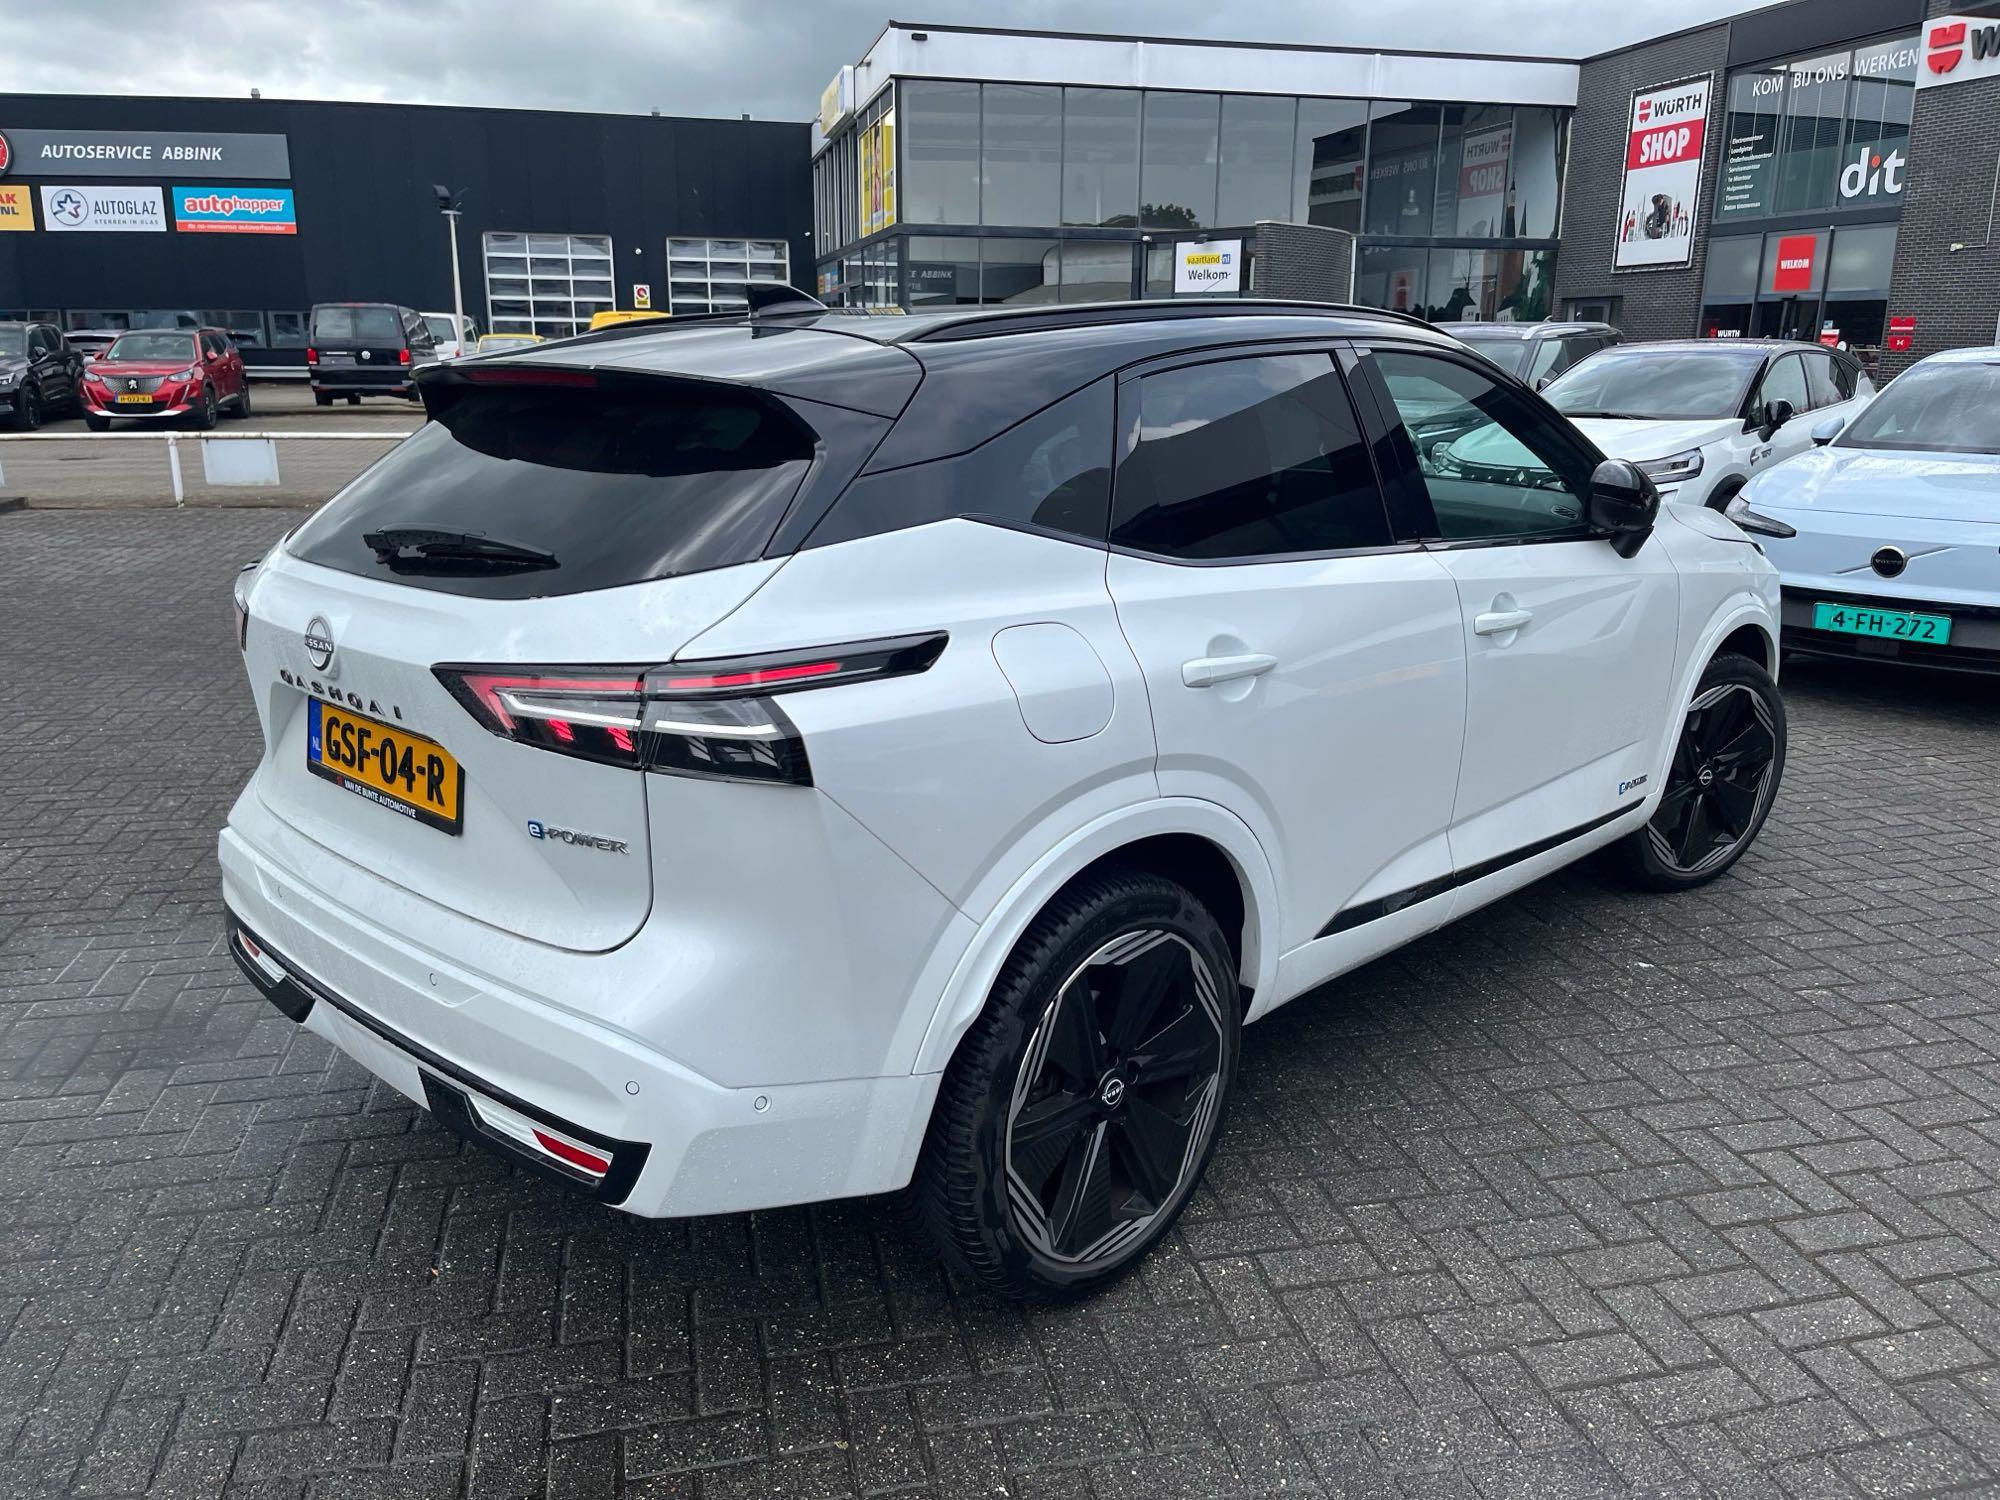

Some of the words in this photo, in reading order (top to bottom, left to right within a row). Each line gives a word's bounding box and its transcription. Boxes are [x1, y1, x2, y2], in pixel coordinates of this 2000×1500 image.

[1752, 76, 1784, 97] KOM
[1793, 71, 1811, 89] BIJ
[1815, 63, 1845, 84] ONS
[1855, 48, 1919, 77] WERKEN
[1654, 93, 1702, 117] WÜRTH
[41, 145, 152, 160] AUTOSERVICE
[162, 147, 222, 161] ABBINK
[1640, 128, 1690, 163] SHOP
[1840, 147, 1905, 198] dit
[94, 200, 158, 215] AUTOGLAZ
[185, 195, 285, 215] autohopper
[1187, 269, 1228, 280] Welkom
[1781, 259, 1809, 269] WELKOM
[1832, 611, 1940, 639] 4-FH-272
[312, 735, 321, 751] NL
[325, 715, 446, 807] GSF-04-R
[344, 779, 355, 791] VAN
[355, 783, 362, 795] DE
[362, 787, 379, 802] BUNTE
[379, 795, 416, 818] AUTOMOTIVE
